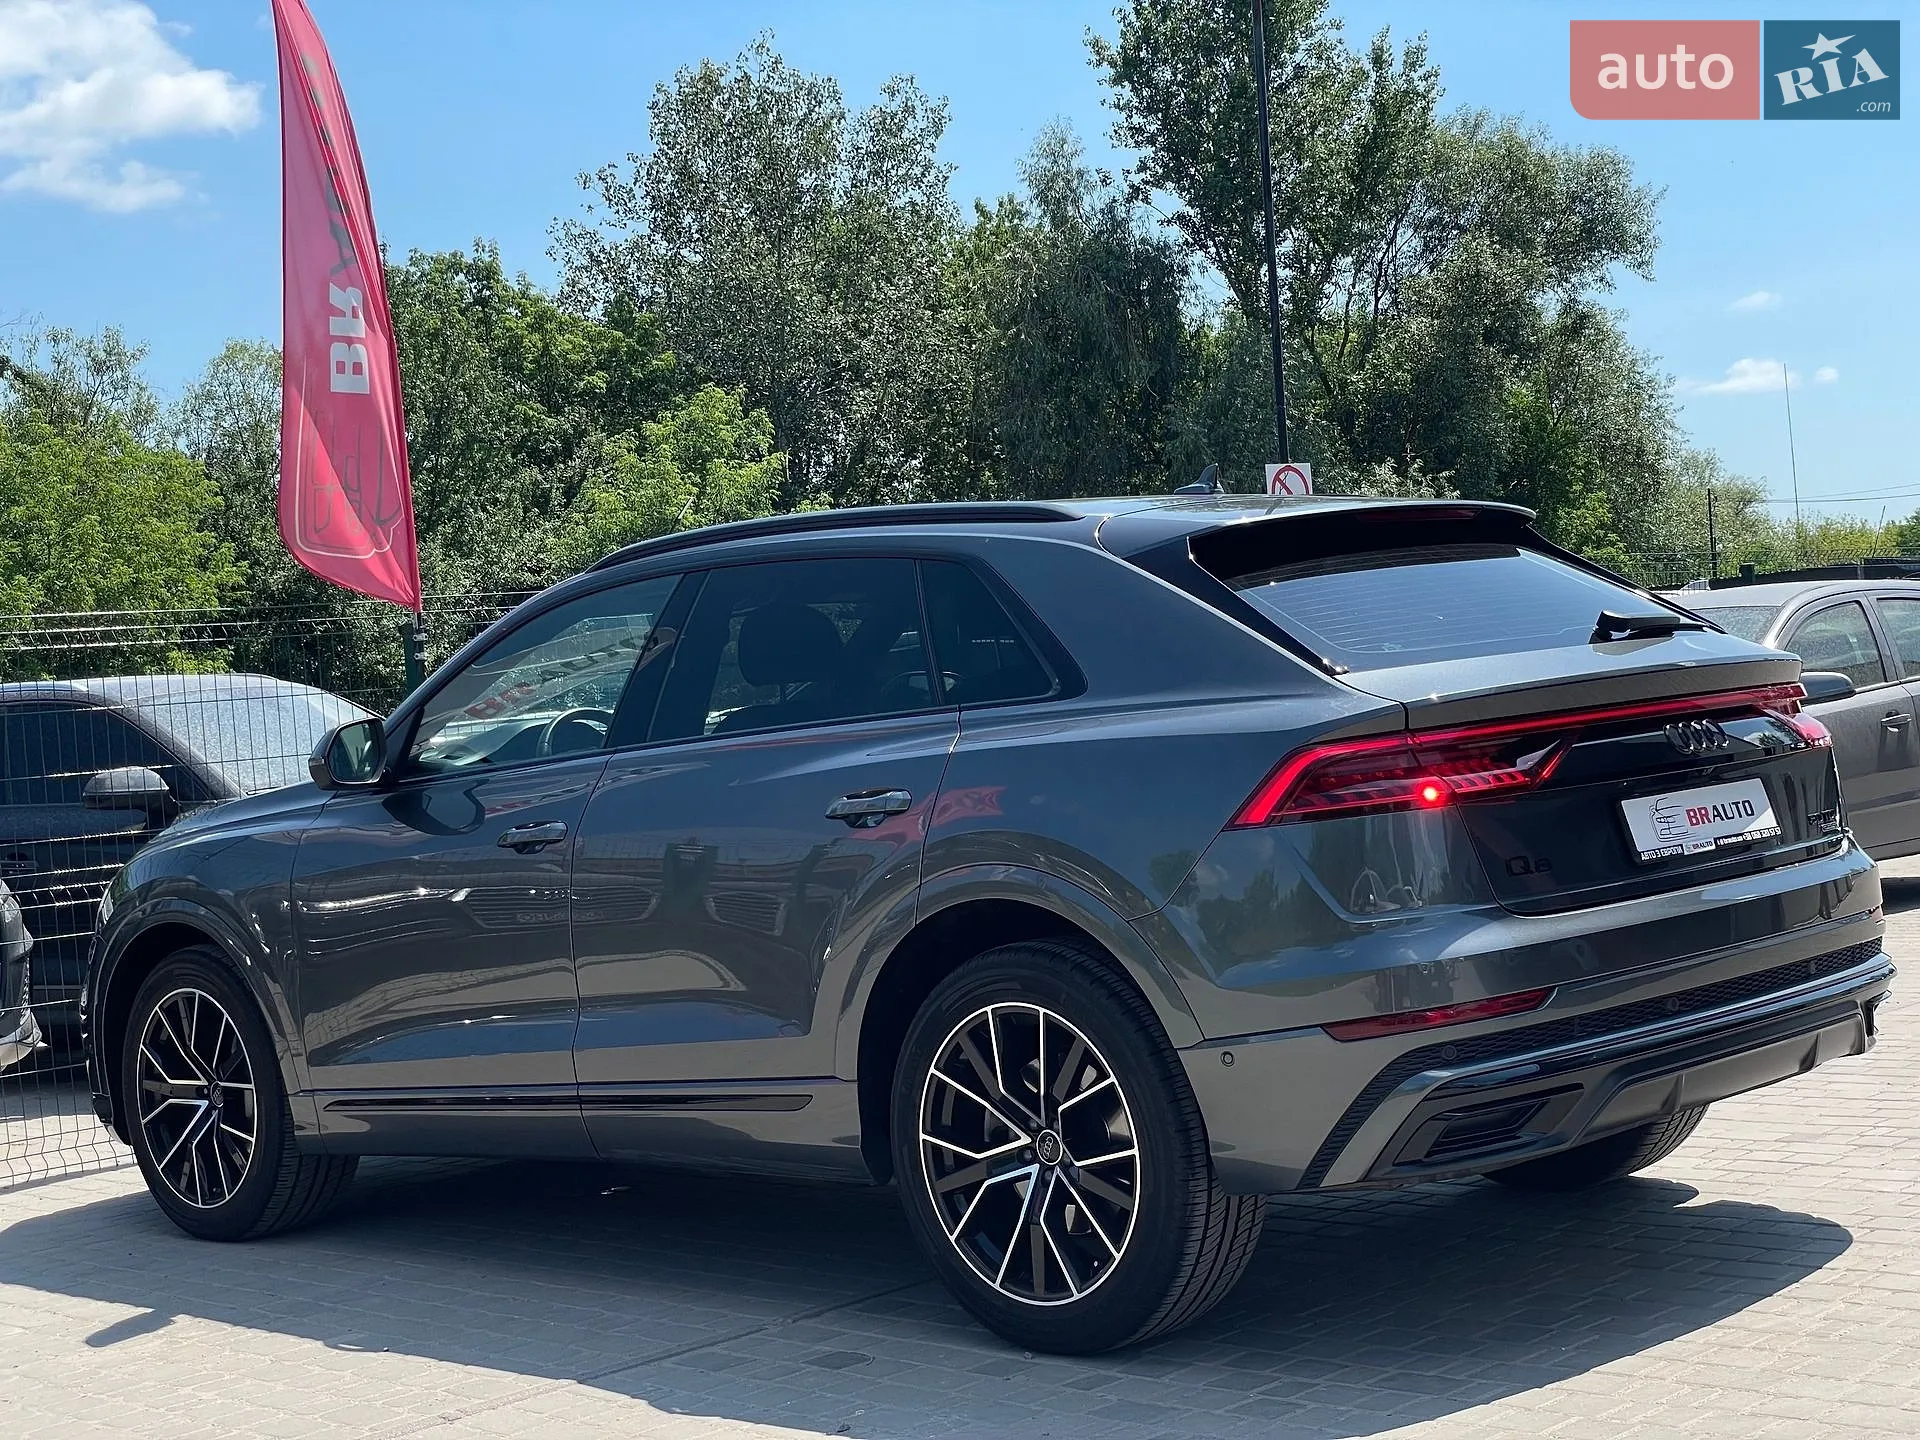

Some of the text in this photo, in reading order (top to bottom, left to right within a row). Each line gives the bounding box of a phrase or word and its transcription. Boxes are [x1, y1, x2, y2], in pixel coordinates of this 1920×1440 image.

[1685, 800, 1755, 827] BRAUTO
[1692, 841, 1714, 850] BRAUTO
[1505, 855, 1552, 878] Q8
